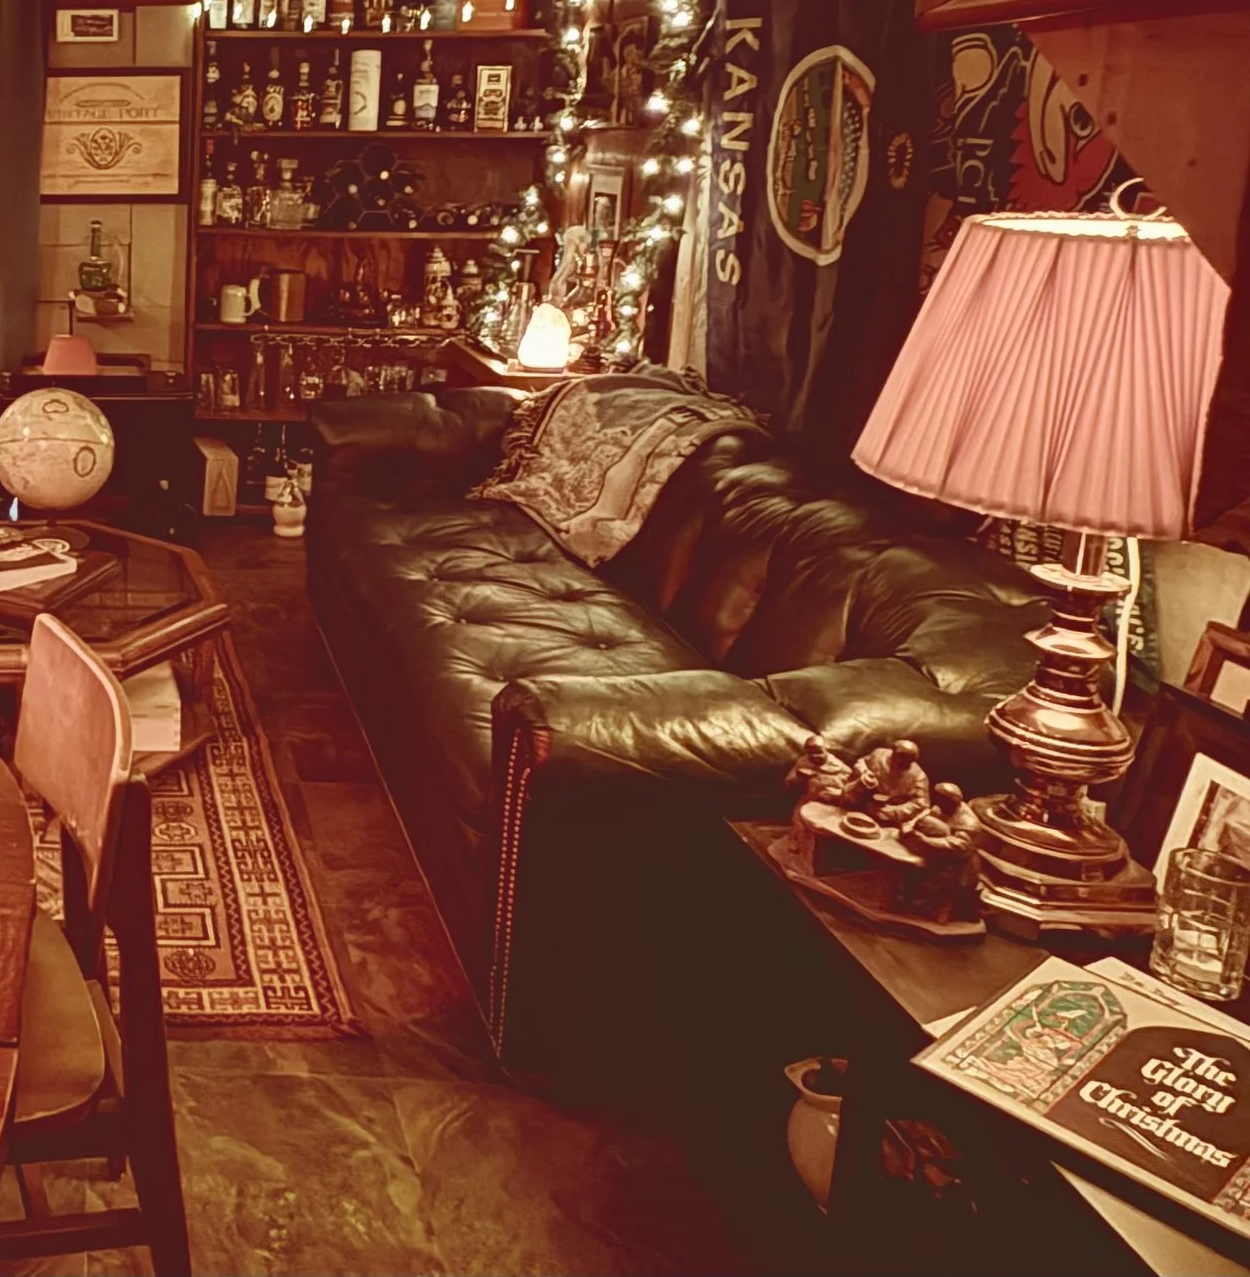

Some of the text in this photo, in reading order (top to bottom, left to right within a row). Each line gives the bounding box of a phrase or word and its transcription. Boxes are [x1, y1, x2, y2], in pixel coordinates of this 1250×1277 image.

[714, 17, 763, 285] KANSAS
[1141, 1058, 1237, 1114] Glory
[1172, 1047, 1237, 1087] The
[1079, 1080, 1238, 1168] Christmas
[1150, 1091, 1199, 1116] of
